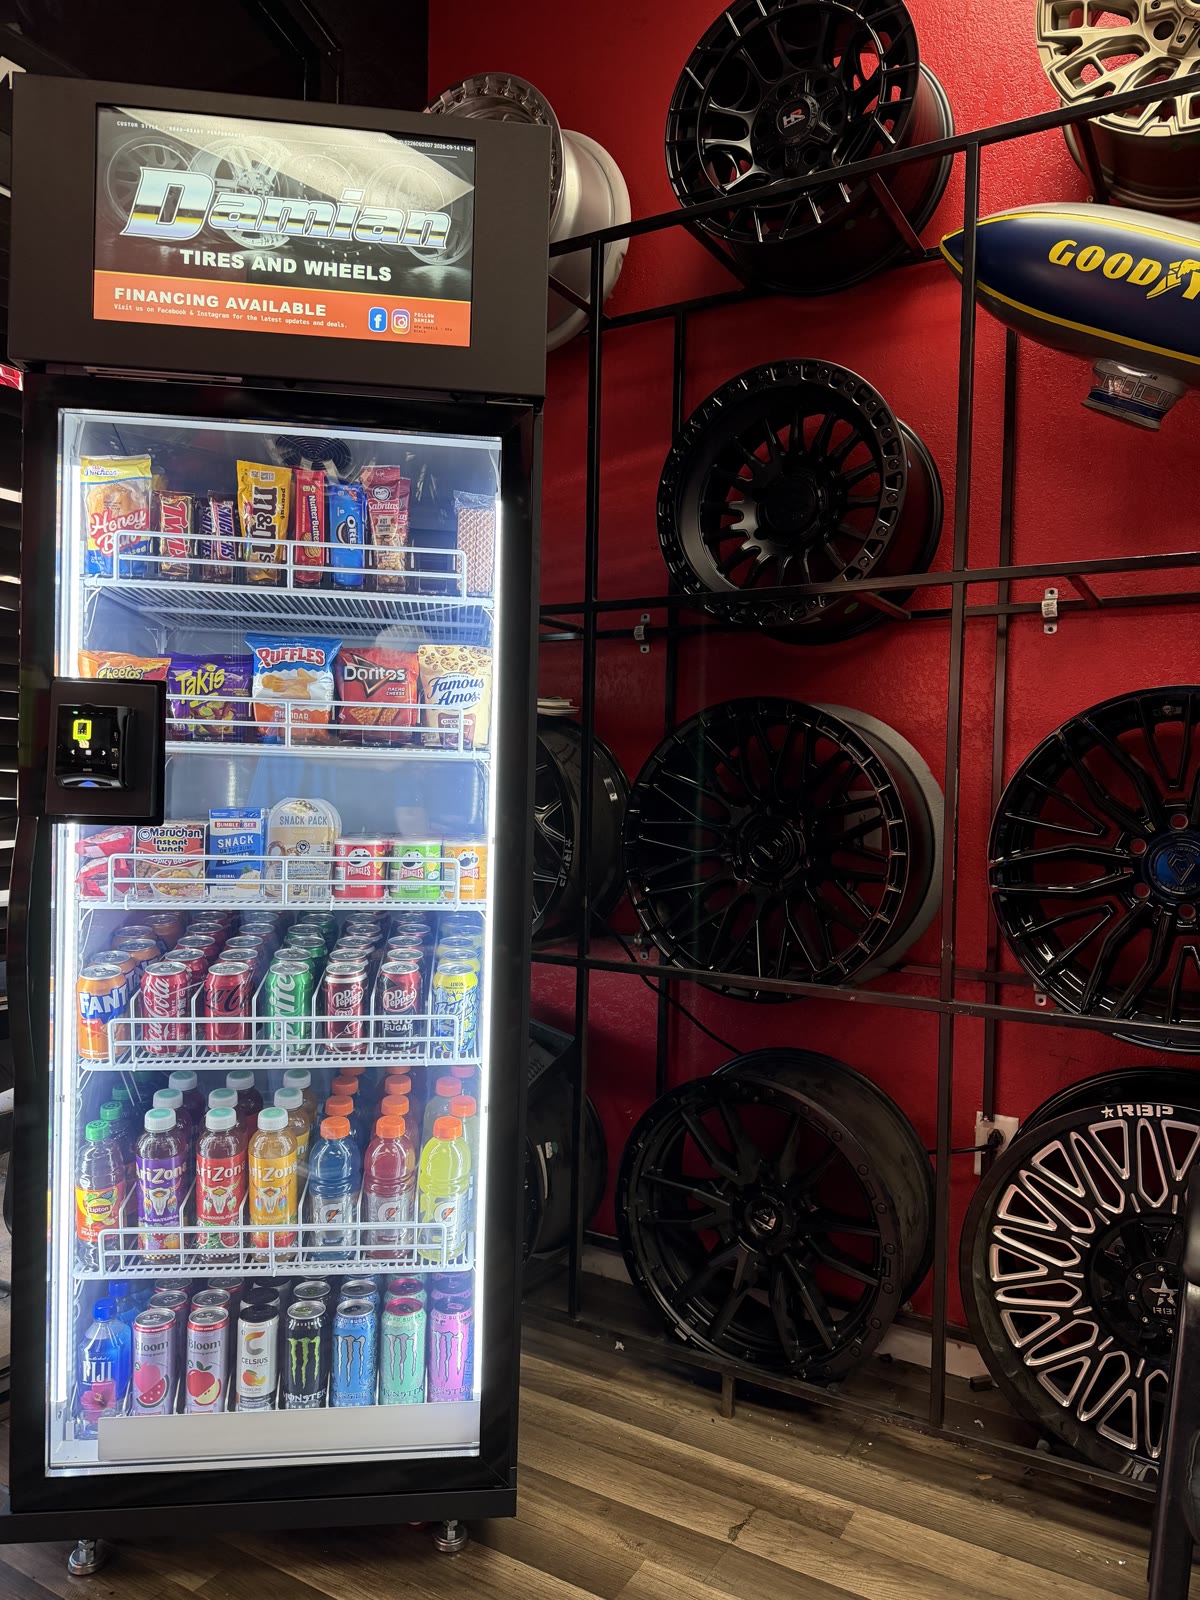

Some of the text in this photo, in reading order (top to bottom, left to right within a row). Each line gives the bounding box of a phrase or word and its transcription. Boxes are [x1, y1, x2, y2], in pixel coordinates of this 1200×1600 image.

[117, 120, 139, 128] CUSTOM
[119, 167, 452, 249] Damian
[179, 249, 392, 282] TIRES AND WHEELS
[114, 287, 327, 317] FINANCING AVAILABLE
[114, 303, 132, 311] Visit
[157, 307, 186, 315] Facebook
[196, 310, 229, 319] Instagram
[260, 315, 282, 323] latest
[285, 317, 310, 326] updates
[313, 319, 324, 327] and
[90, 510, 147, 535] Honey
[312, 520, 320, 543] Butte
[257, 647, 325, 668] RUFFLES
[344, 665, 406, 681] Doritos
[175, 663, 226, 705] Takis
[427, 675, 485, 699] Famous
[437, 690, 478, 706] Amos
[279, 815, 328, 826] SNACK PACK
[150, 827, 201, 839] Maruchan
[153, 838, 188, 846] Instant
[217, 834, 254, 848] SNACK
[347, 865, 371, 876] PRINGLES
[401, 867, 424, 879] PRINGLES
[459, 867, 479, 879] RINGLES
[335, 988, 362, 1008] Pepper
[385, 990, 415, 1008] Pepper
[394, 989, 407, 997] Dr
[385, 1024, 414, 1032] SUGAR
[1152, 1306, 1175, 1315] RB
[135, 1337, 169, 1352] Bloom
[187, 1338, 221, 1351] Bloom
[241, 1356, 269, 1365] CELSIUS
[82, 1361, 112, 1383] FIJI
